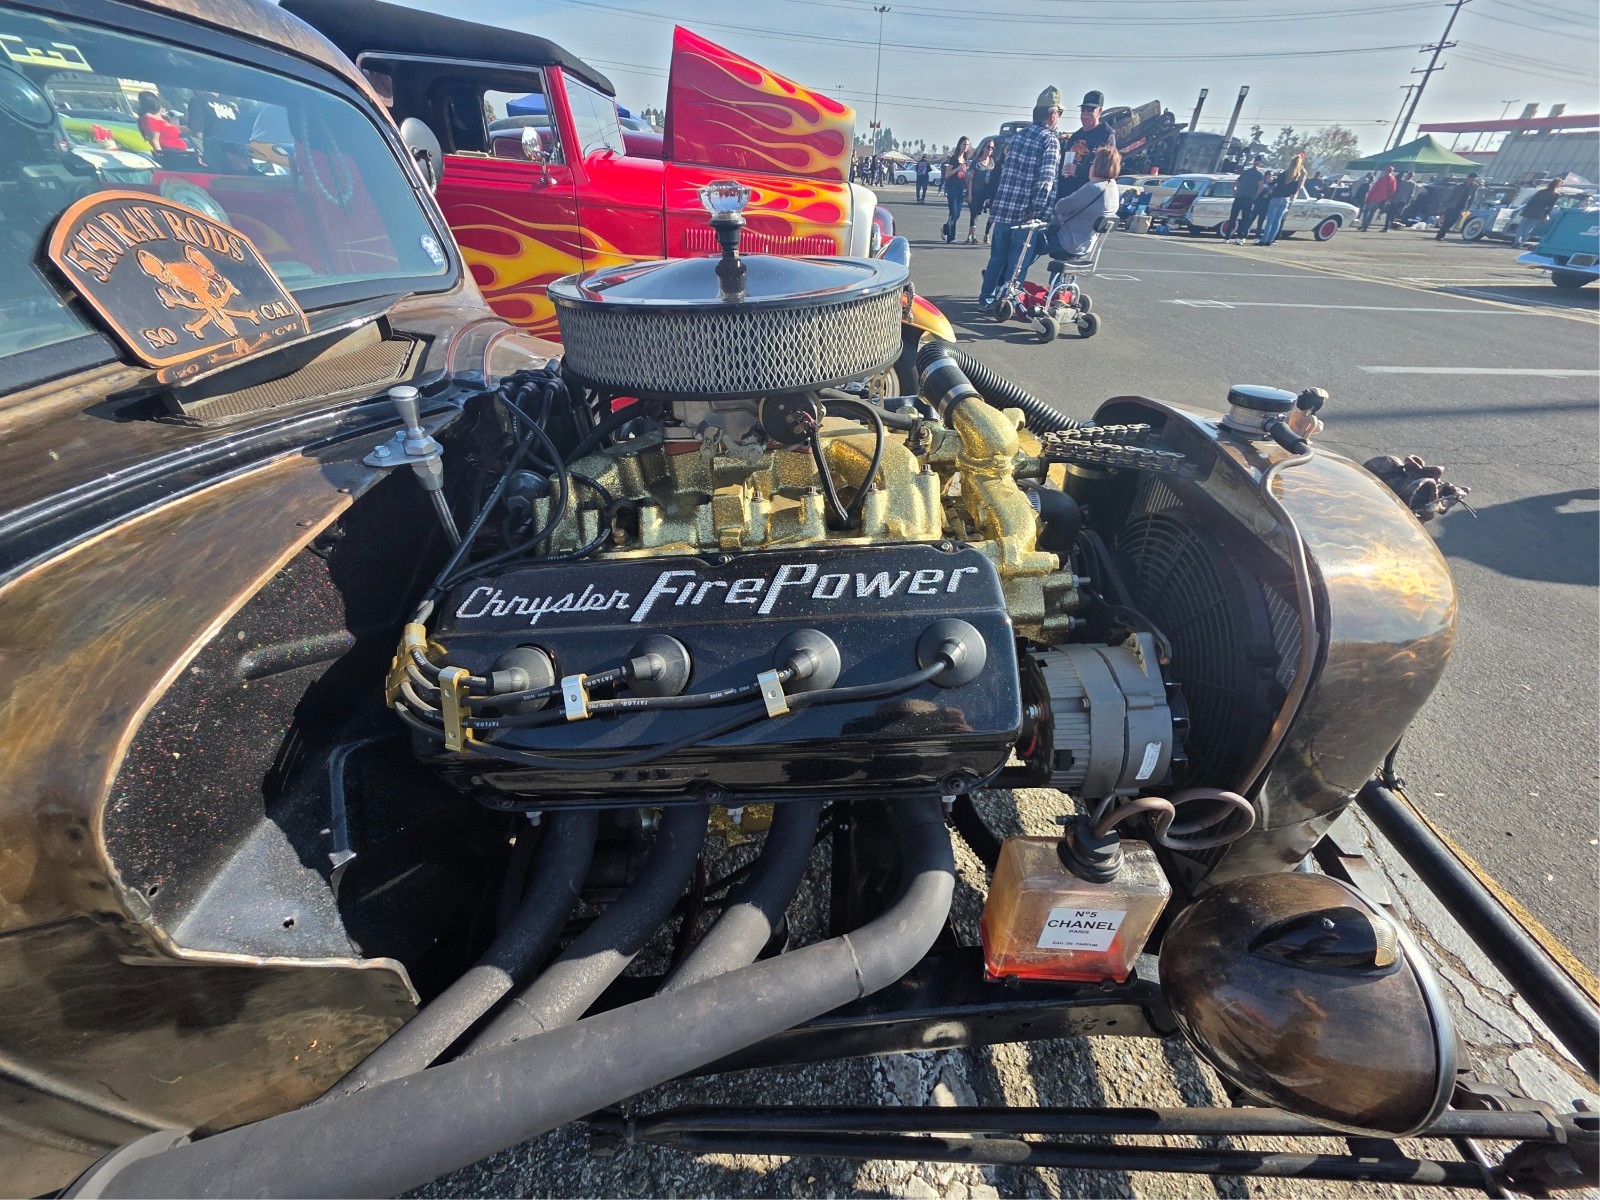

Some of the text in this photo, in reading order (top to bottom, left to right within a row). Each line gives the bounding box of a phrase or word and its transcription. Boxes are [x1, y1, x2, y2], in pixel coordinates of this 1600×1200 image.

[64, 206, 245, 282] 5150 RAT RODS
[143, 301, 294, 349] SO CAL
[456, 563, 978, 624] Chrysler FirePower
[1047, 920, 1116, 930] CHANEL
